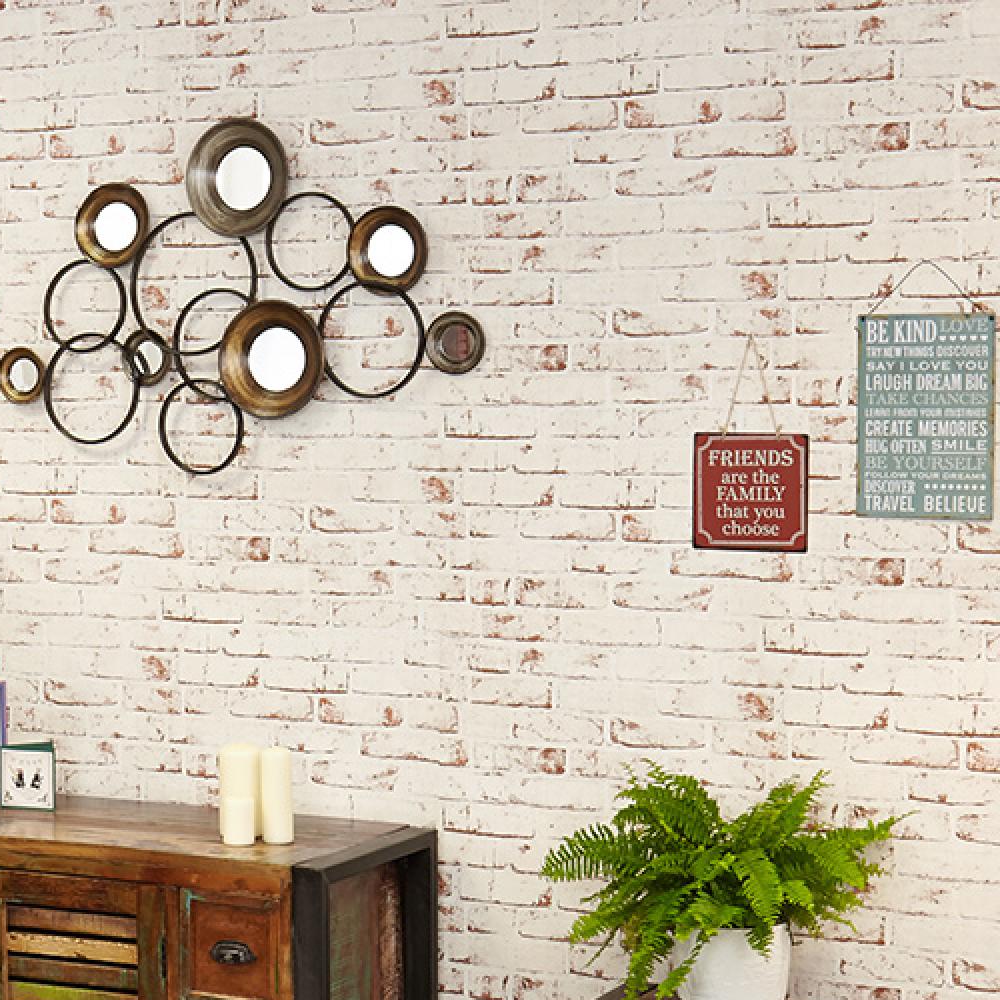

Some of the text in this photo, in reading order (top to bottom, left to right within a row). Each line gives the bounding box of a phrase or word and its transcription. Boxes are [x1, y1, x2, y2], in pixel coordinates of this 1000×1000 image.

[867, 319, 937, 343] BE KIND
[939, 319, 988, 333] LOVE
[935, 345, 988, 358] DISCOVER
[866, 360, 894, 371] SAY
[910, 360, 951, 371] LOVE
[955, 360, 988, 371] YOU
[865, 373, 988, 391] LAUGH DREAM BIG
[866, 392, 989, 405] TAKE CHANCES
[865, 419, 988, 435] CREATE MEMORIES
[891, 439, 927, 455] OFTEN
[931, 439, 987, 451] SMILE
[708, 449, 795, 467] FRIENDS
[865, 455, 987, 470] BE YOURSELF
[721, 468, 781, 485] are the
[864, 471, 987, 480] FOLLOW YOUR DREAMS
[716, 485, 787, 502] FAMILY
[864, 479, 917, 494] DISCOVER
[864, 495, 915, 512] TRAVEL
[715, 503, 786, 524] that you
[721, 519, 781, 537] choose
